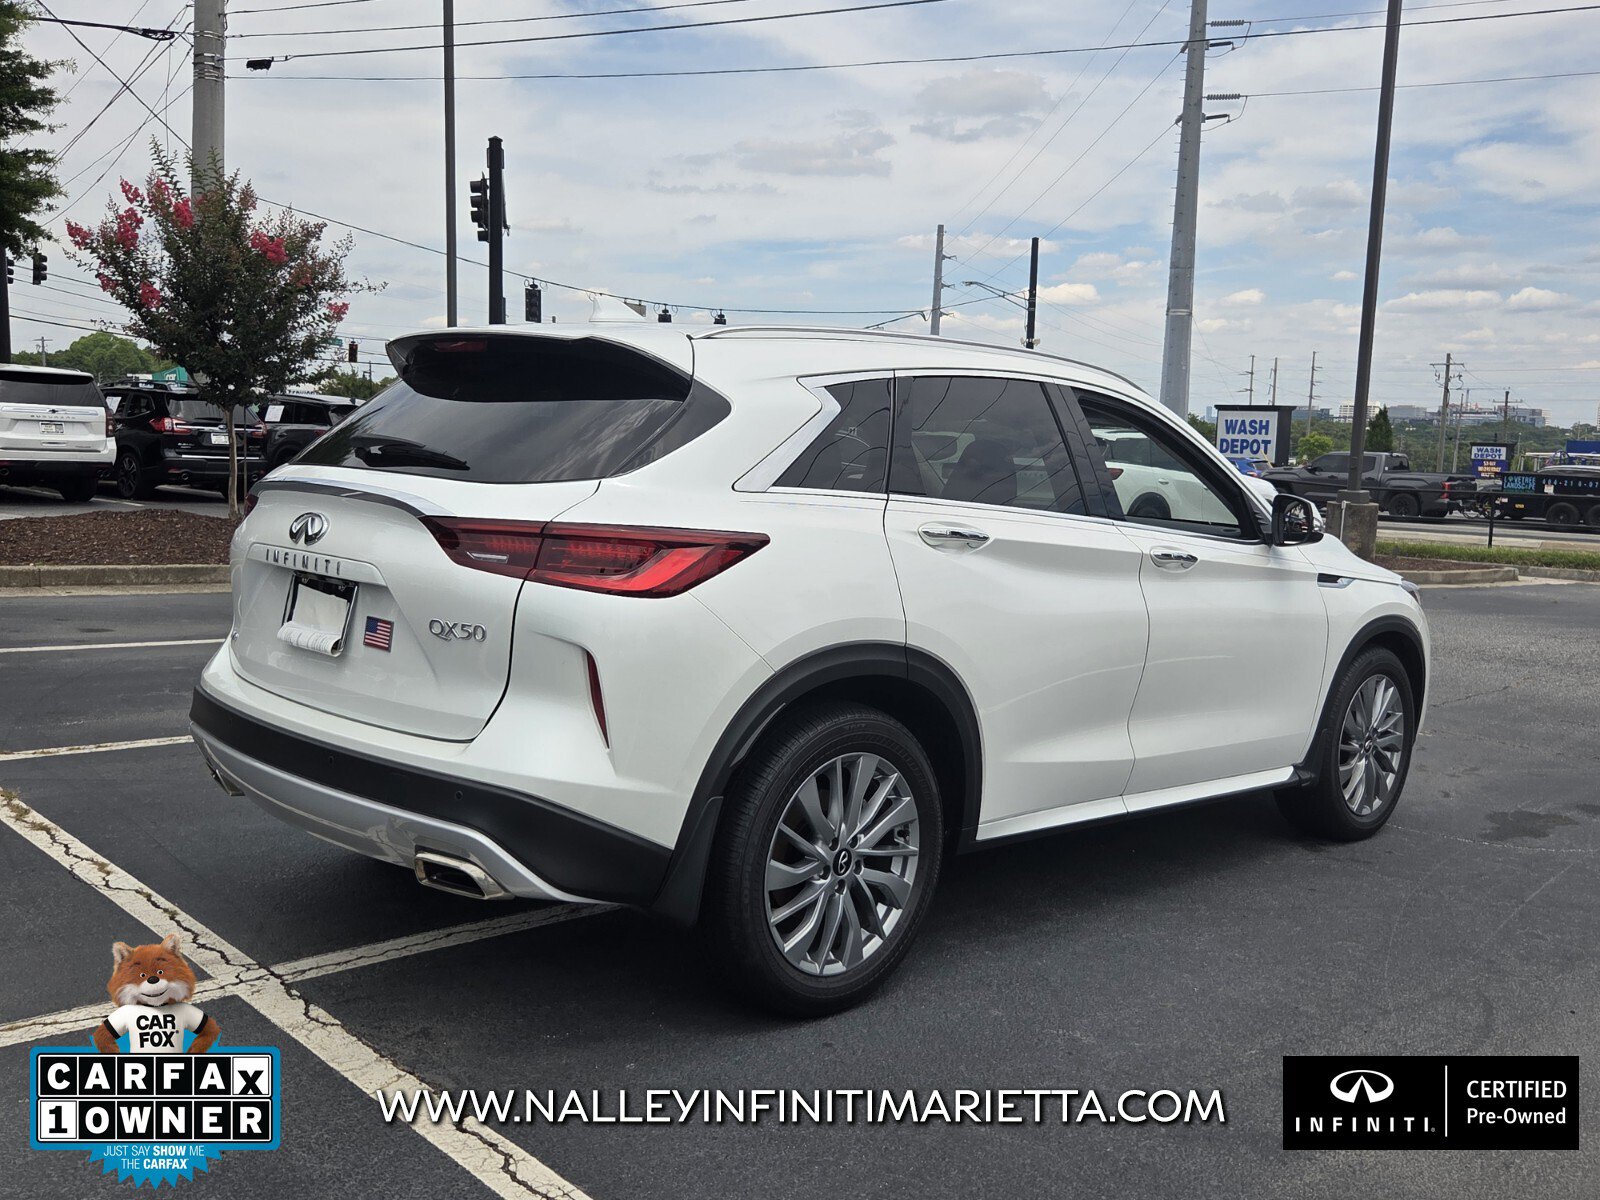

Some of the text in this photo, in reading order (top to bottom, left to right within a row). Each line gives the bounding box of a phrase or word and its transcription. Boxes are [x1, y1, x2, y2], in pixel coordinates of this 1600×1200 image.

[1224, 419, 1270, 435] WASH
[1219, 438, 1272, 455] DEPOT
[265, 548, 341, 576] INFINITI
[428, 618, 487, 643] QX50
